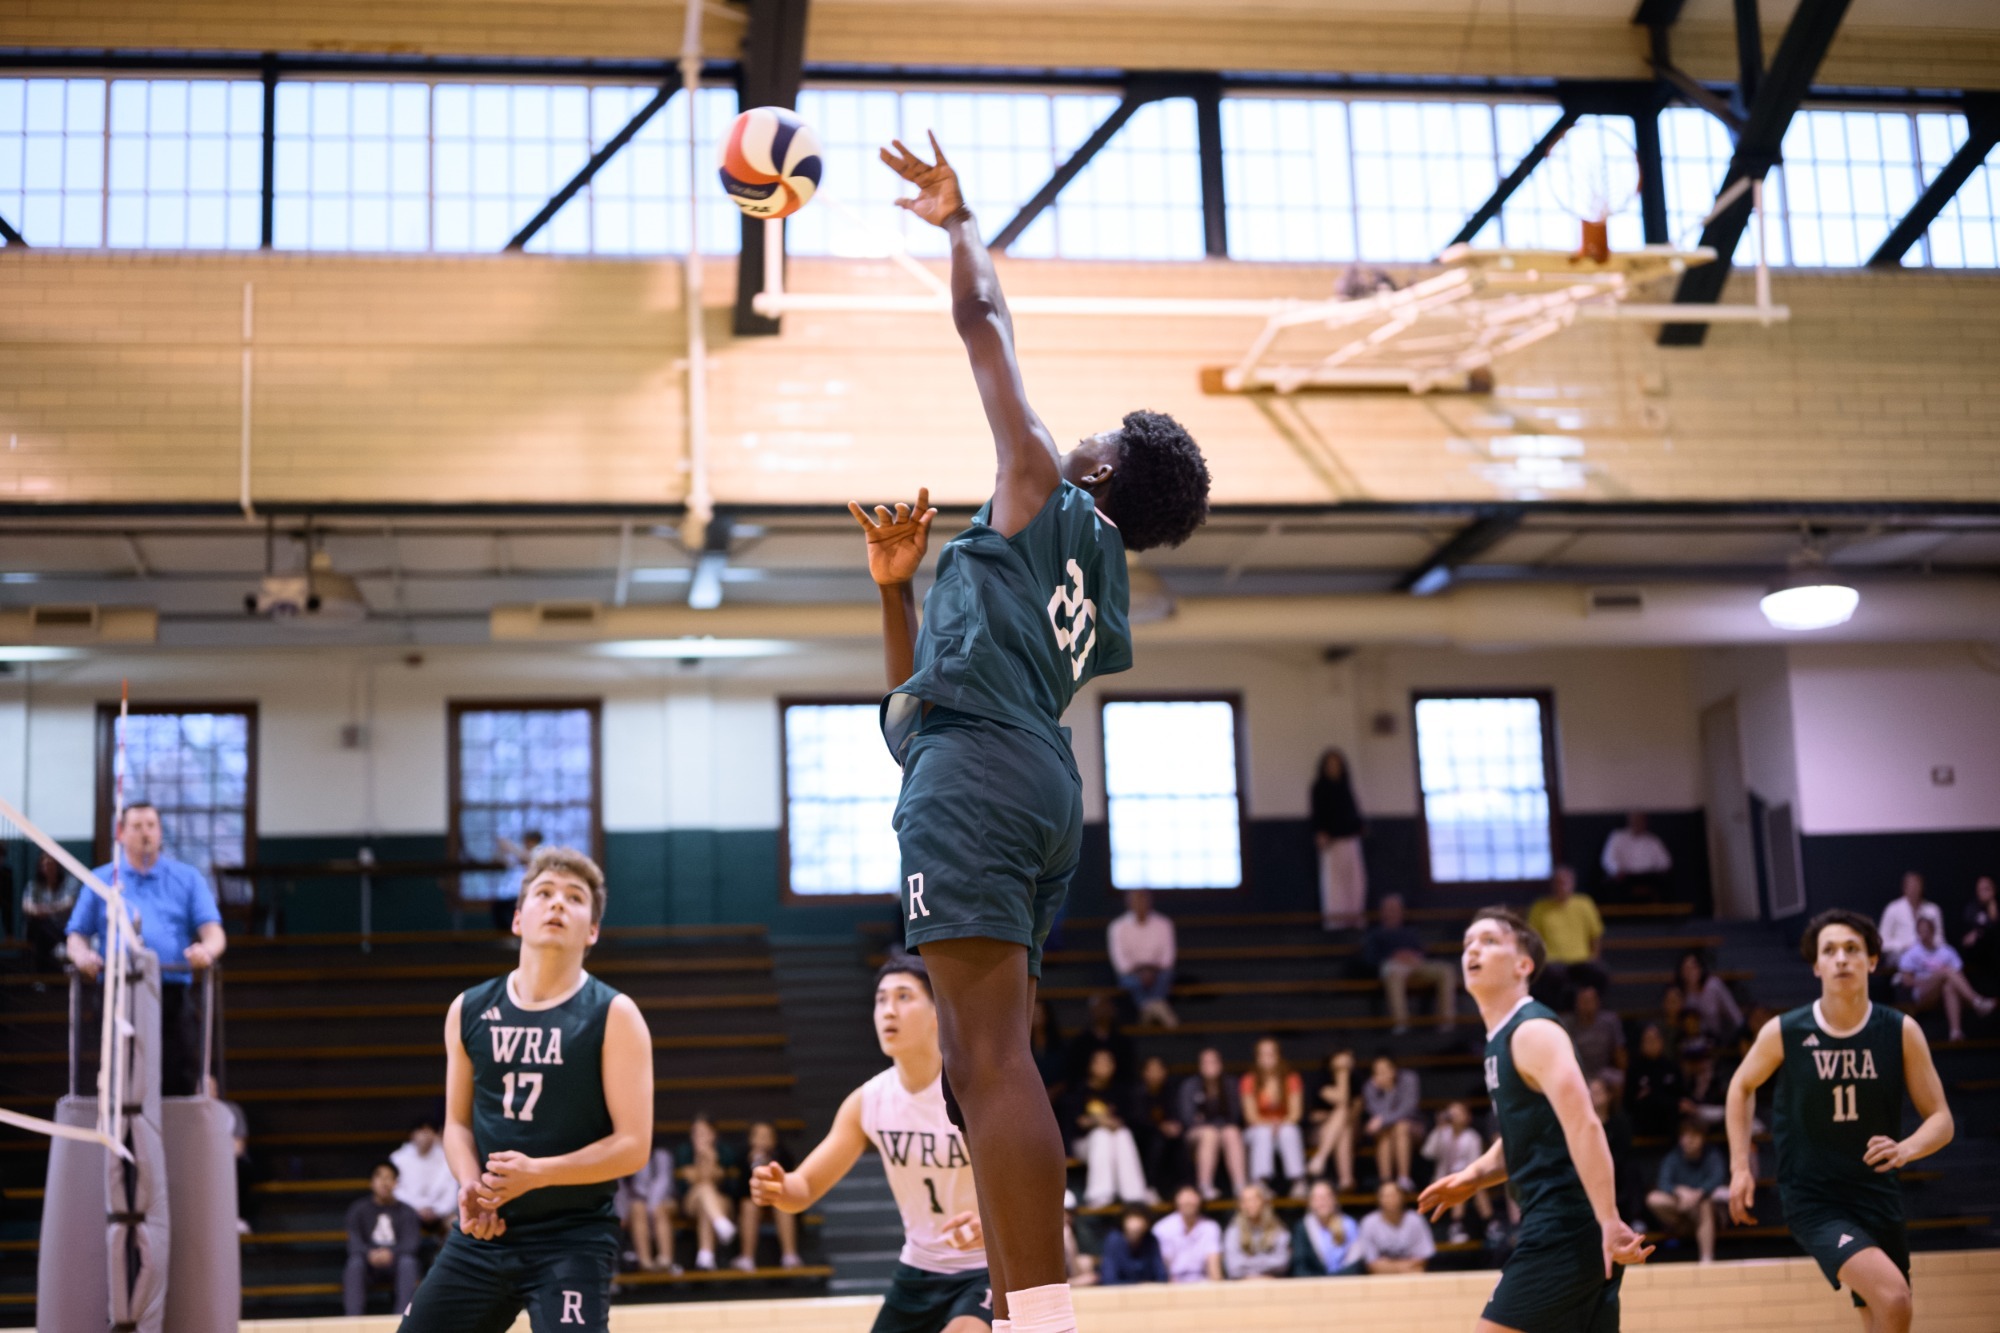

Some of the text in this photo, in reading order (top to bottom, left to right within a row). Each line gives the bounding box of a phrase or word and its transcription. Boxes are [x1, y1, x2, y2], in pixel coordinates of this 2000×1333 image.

[907, 872, 930, 920] R
[489, 1026, 564, 1065] WRA
[1812, 1049, 1878, 1080] WRA
[502, 1072, 543, 1121] 17
[1832, 1084, 1859, 1122] 11
[877, 1130, 969, 1168] WRA
[923, 1178, 944, 1214] 1
[560, 1290, 586, 1325] R
